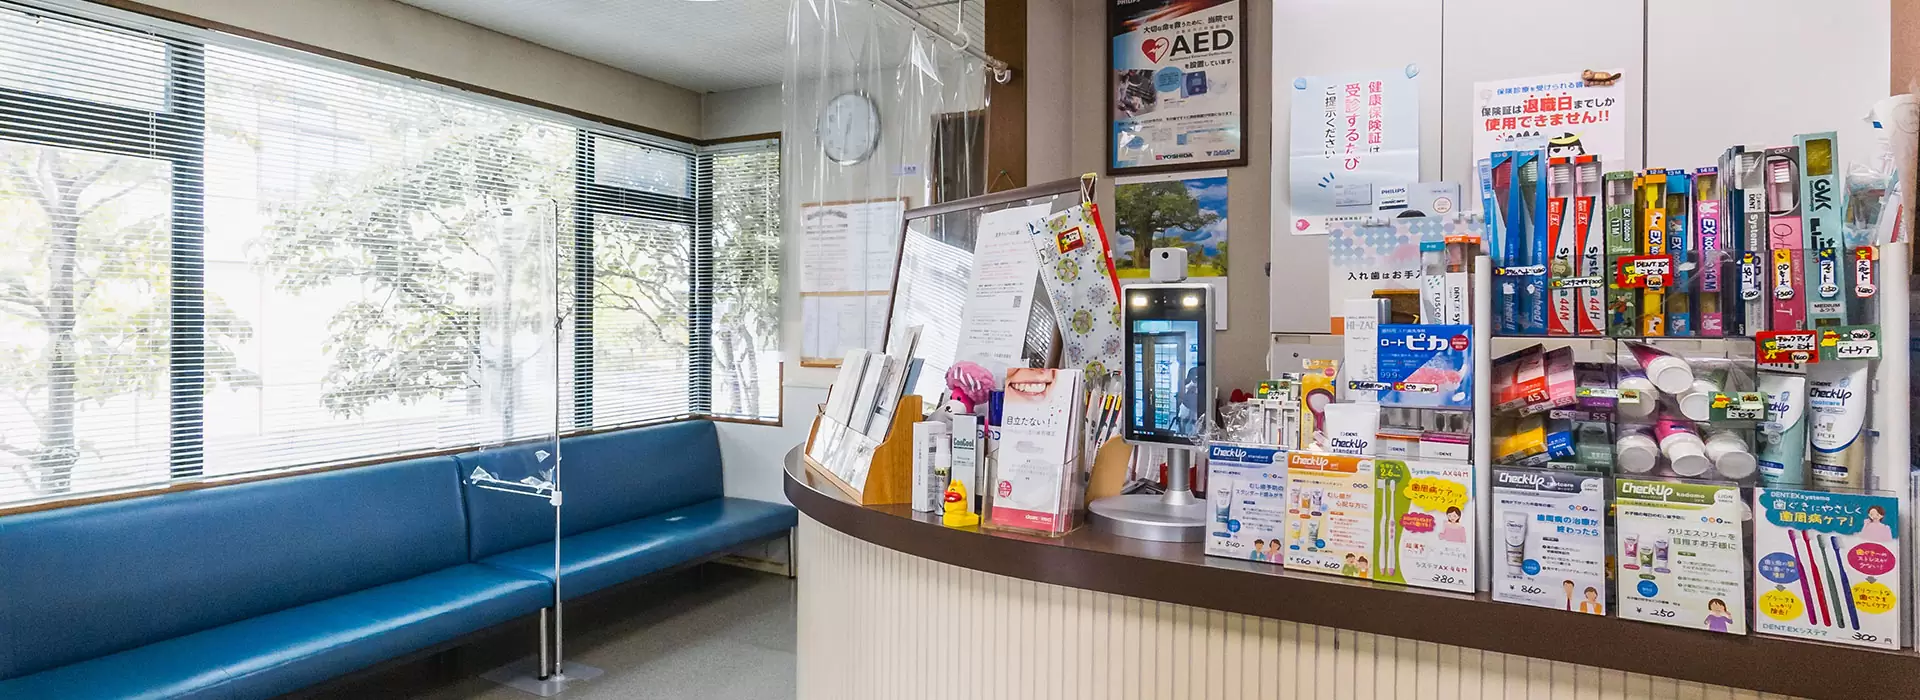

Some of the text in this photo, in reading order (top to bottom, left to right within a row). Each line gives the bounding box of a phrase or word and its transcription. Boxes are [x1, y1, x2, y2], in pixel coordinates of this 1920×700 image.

[1169, 29, 1234, 57] AED
[1482, 96, 1615, 117] 保険証は退職日までしか
[1325, 85, 1337, 159] ご提示ください
[1368, 81, 1382, 153] 健康保険証は
[1485, 110, 1609, 132] 使用できません!!
[1345, 83, 1360, 170] 受診するたび
[1162, 152, 1193, 160] YOSHIDA
[1381, 186, 1406, 196] PHILIPS
[1814, 178, 1832, 211] GVK
[1702, 218, 1716, 234] EX
[1748, 213, 1759, 251] Systema
[1586, 246, 1601, 320] Systea 44H
[1559, 298, 1570, 321] 44M
[1380, 332, 1449, 351] ロートピカ
[1592, 412, 1607, 420] SS
[1773, 499, 1863, 515] 歯ぐきにやさしく
[1536, 514, 1599, 526] 歯周病の治療が
[1556, 526, 1599, 537] 終わったら
[1667, 527, 1736, 541] カリエスフリーを
[1672, 537, 1737, 550] 目指すお子様に
[1324, 561, 1341, 570] 600
[1650, 607, 1676, 618] 250
[1852, 631, 1878, 642] 300
